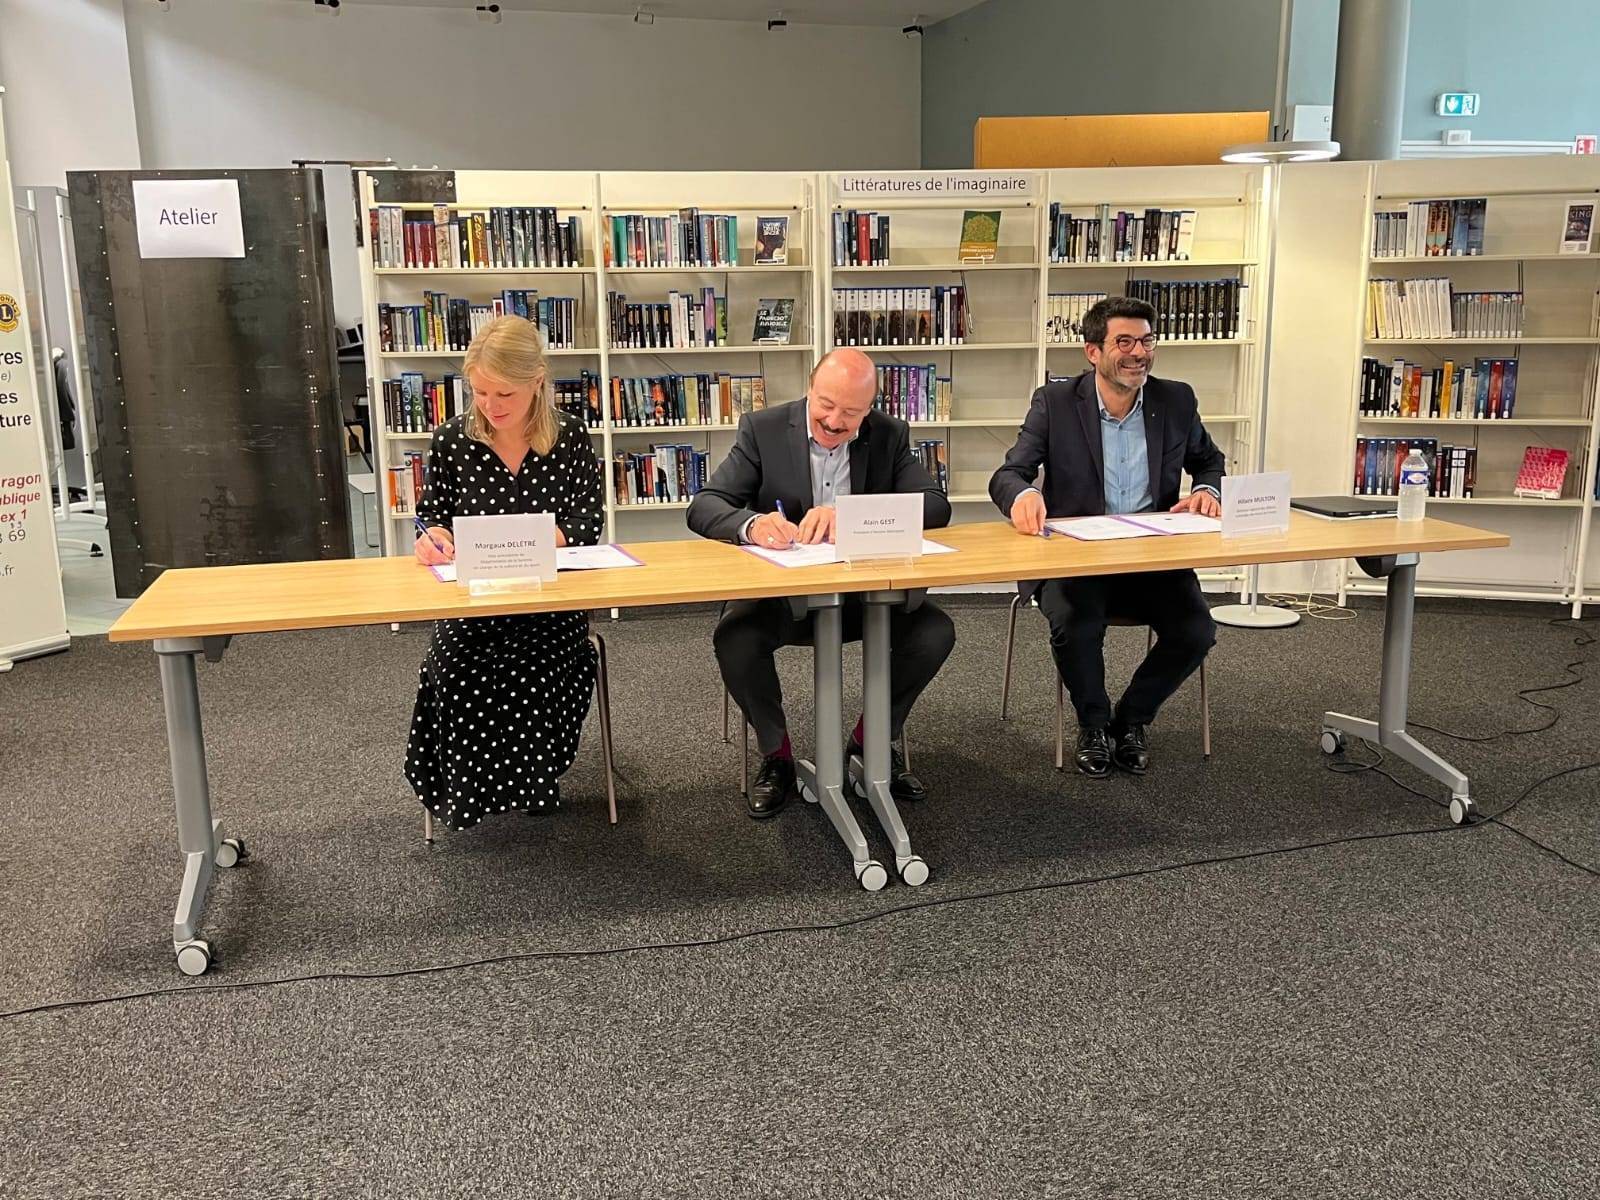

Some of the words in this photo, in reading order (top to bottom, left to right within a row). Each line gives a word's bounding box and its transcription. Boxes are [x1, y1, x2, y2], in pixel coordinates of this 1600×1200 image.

[843, 177, 921, 191] Littératures
[925, 177, 943, 191] de
[946, 176, 1027, 193] l'imaginaire
[159, 207, 218, 225] Atelier
[2, 474, 41, 489] ragon
[21, 509, 27, 520] 1
[8, 528, 26, 542] 69
